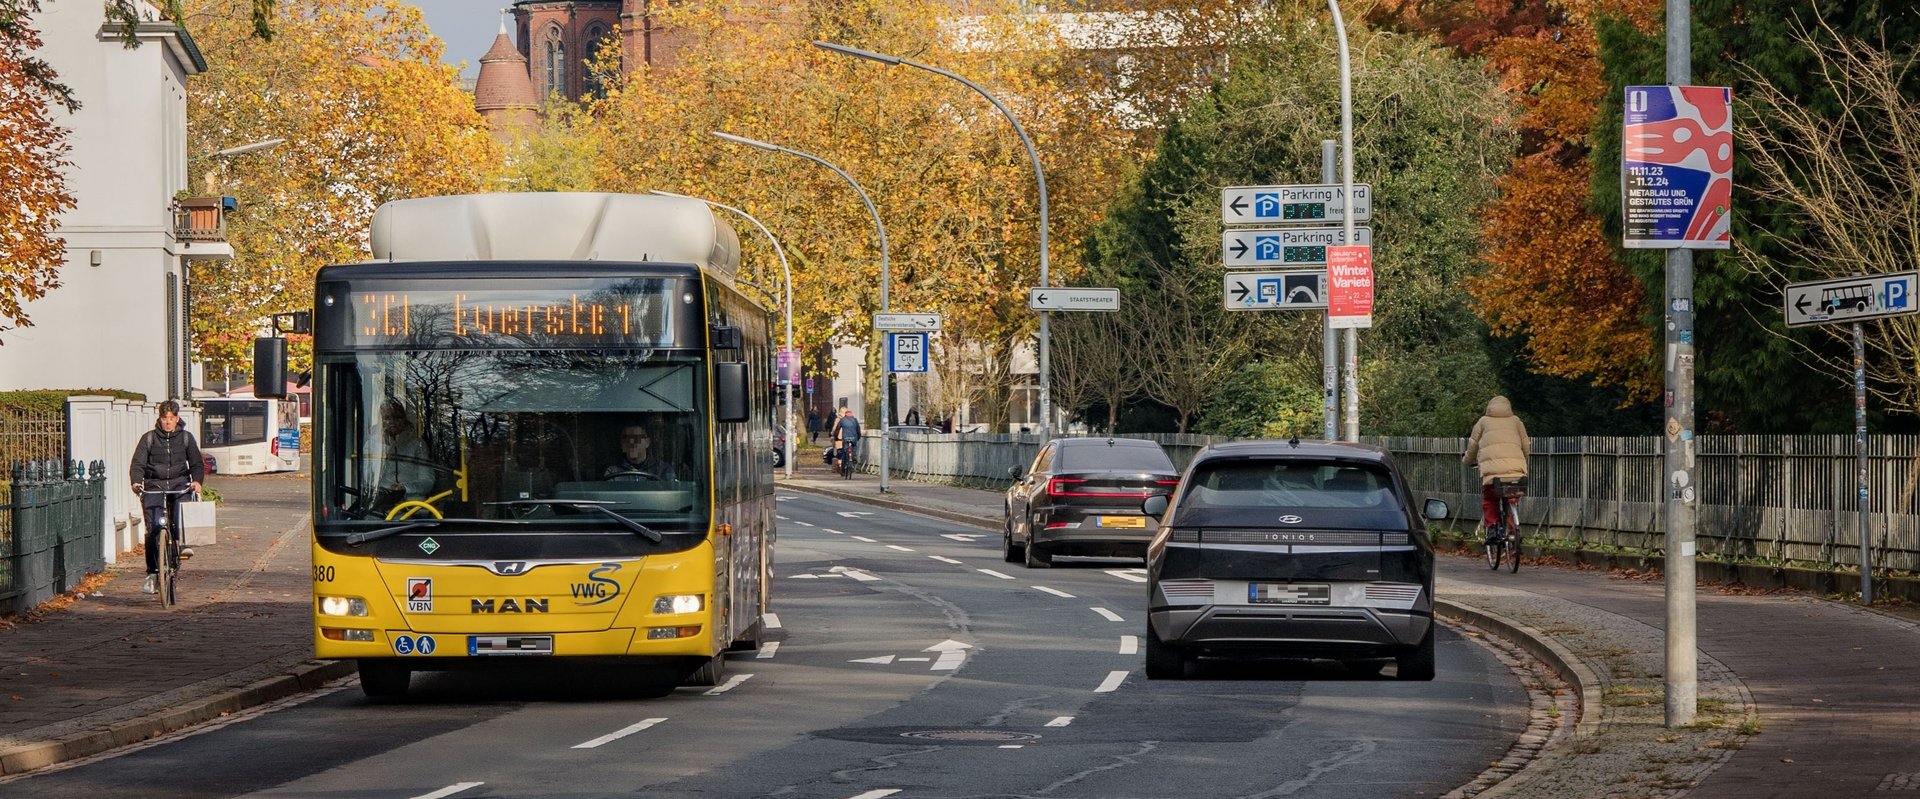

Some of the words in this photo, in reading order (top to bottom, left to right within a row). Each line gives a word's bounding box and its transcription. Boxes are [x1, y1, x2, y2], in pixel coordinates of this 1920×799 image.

[1629, 166, 1663, 176] 11.11.23
[1282, 188, 1332, 201] Parkring
[1337, 188, 1365, 198] Nrd
[1629, 189, 1669, 197] METABLAU
[1671, 189, 1686, 197] UND
[1629, 198, 1672, 206] GESTAUTES
[1673, 197, 1694, 206] GRÜN
[1284, 203, 1324, 219] 976
[1283, 231, 1333, 244] Parkring
[1338, 231, 1360, 241] Sd
[1284, 246, 1324, 261] 833
[1332, 265, 1369, 276] Winter
[1332, 277, 1371, 288] Varieté
[1889, 283, 1903, 306] P
[898, 339, 919, 351] P+R
[901, 355, 915, 363] City
[313, 564, 335, 582] 380
[570, 583, 606, 598] VWG
[409, 602, 432, 612] VBN
[471, 598, 549, 614] MAN
